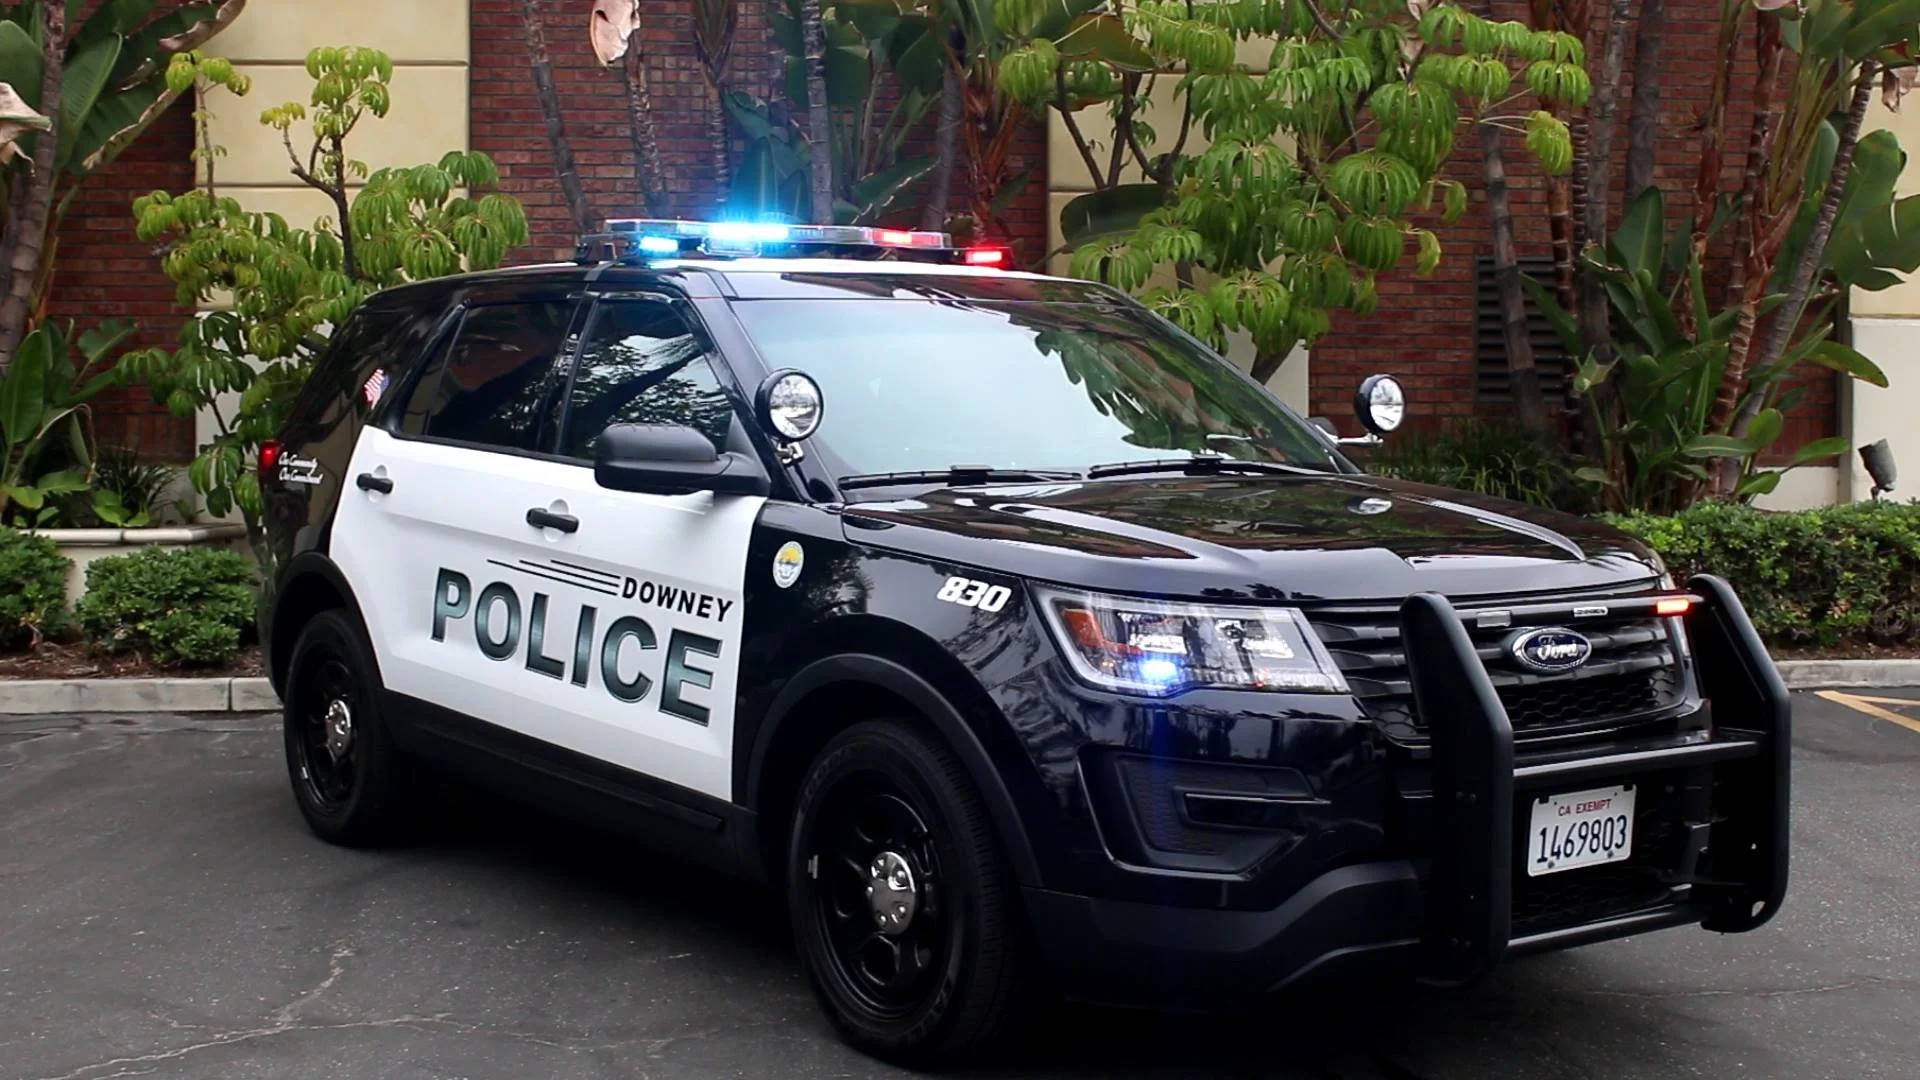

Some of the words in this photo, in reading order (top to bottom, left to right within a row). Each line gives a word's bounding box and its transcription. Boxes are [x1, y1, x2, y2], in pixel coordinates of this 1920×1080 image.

[622, 577, 733, 622] DOWNEY
[937, 576, 1012, 612] 830
[431, 567, 722, 727] POLICE
[1537, 635, 1580, 660] Ford
[1558, 805, 1571, 816] CA
[1576, 799, 1612, 813] EXEMPT
[1537, 815, 1627, 863] 1469803
